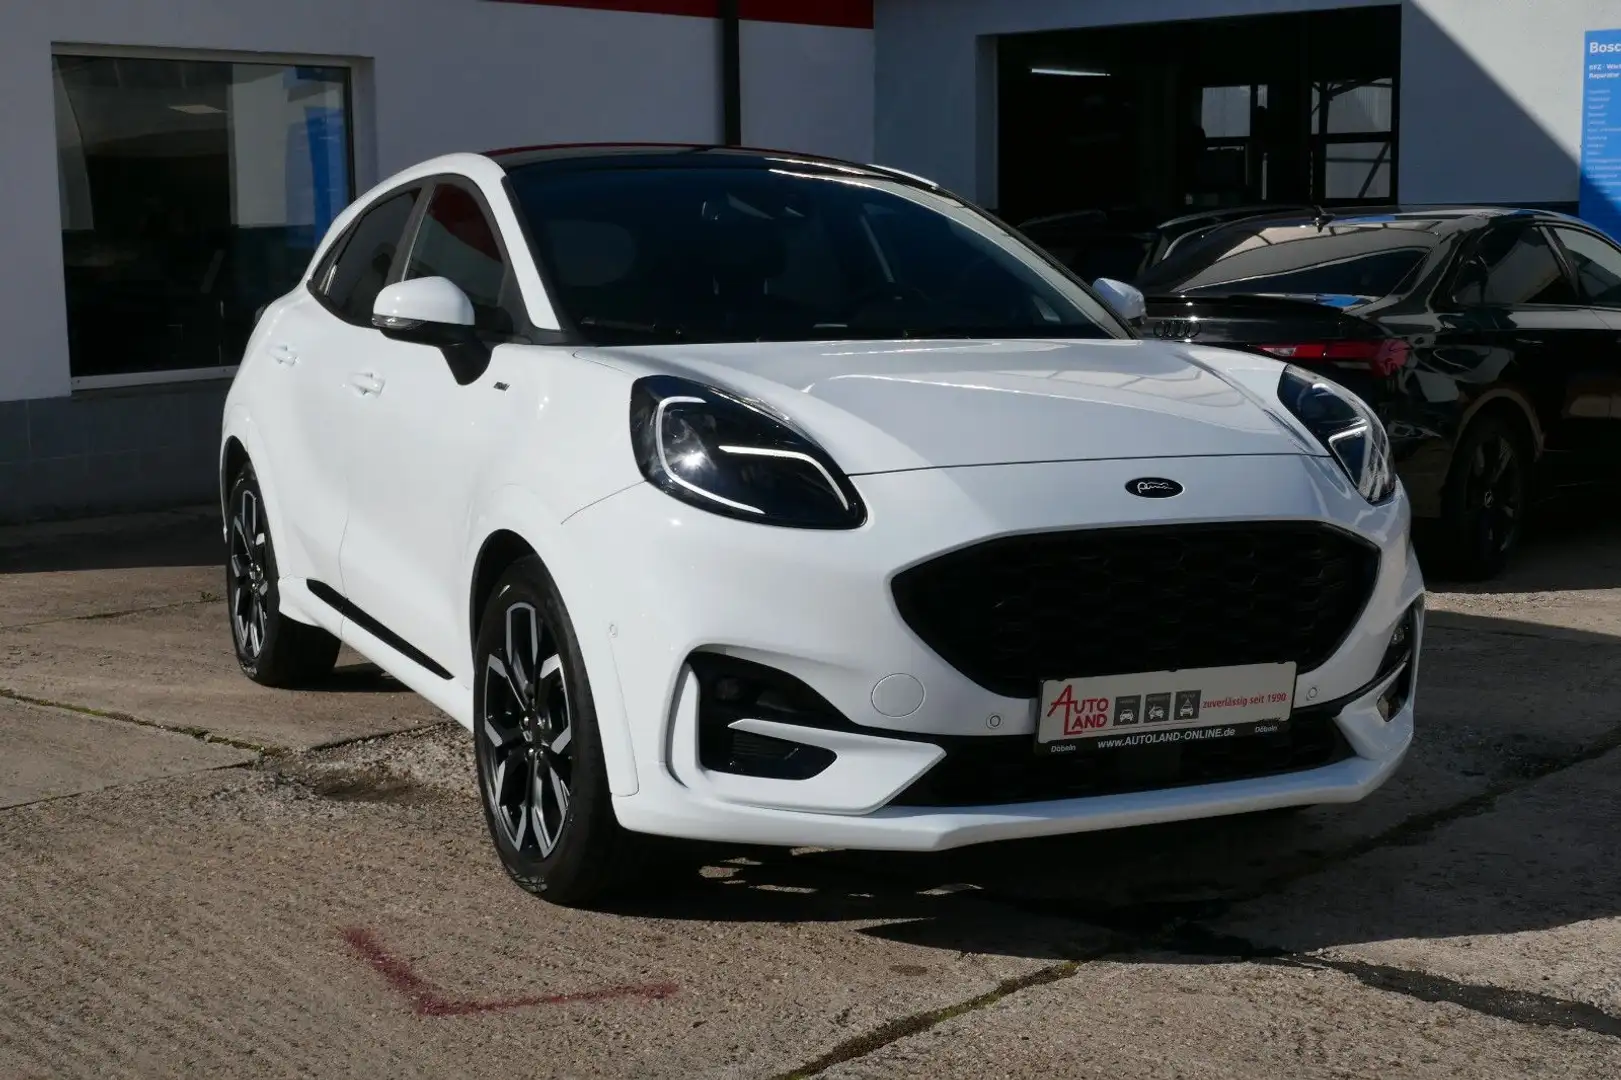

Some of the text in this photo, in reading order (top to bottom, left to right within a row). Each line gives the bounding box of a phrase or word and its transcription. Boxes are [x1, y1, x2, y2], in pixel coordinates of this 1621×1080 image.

[1202, 696, 1248, 709] zuverlässig
[1249, 695, 1265, 705] seit
[1267, 691, 1288, 703] 1990
[1097, 727, 1237, 749] www.AUTOLAND-ONLINE.de
